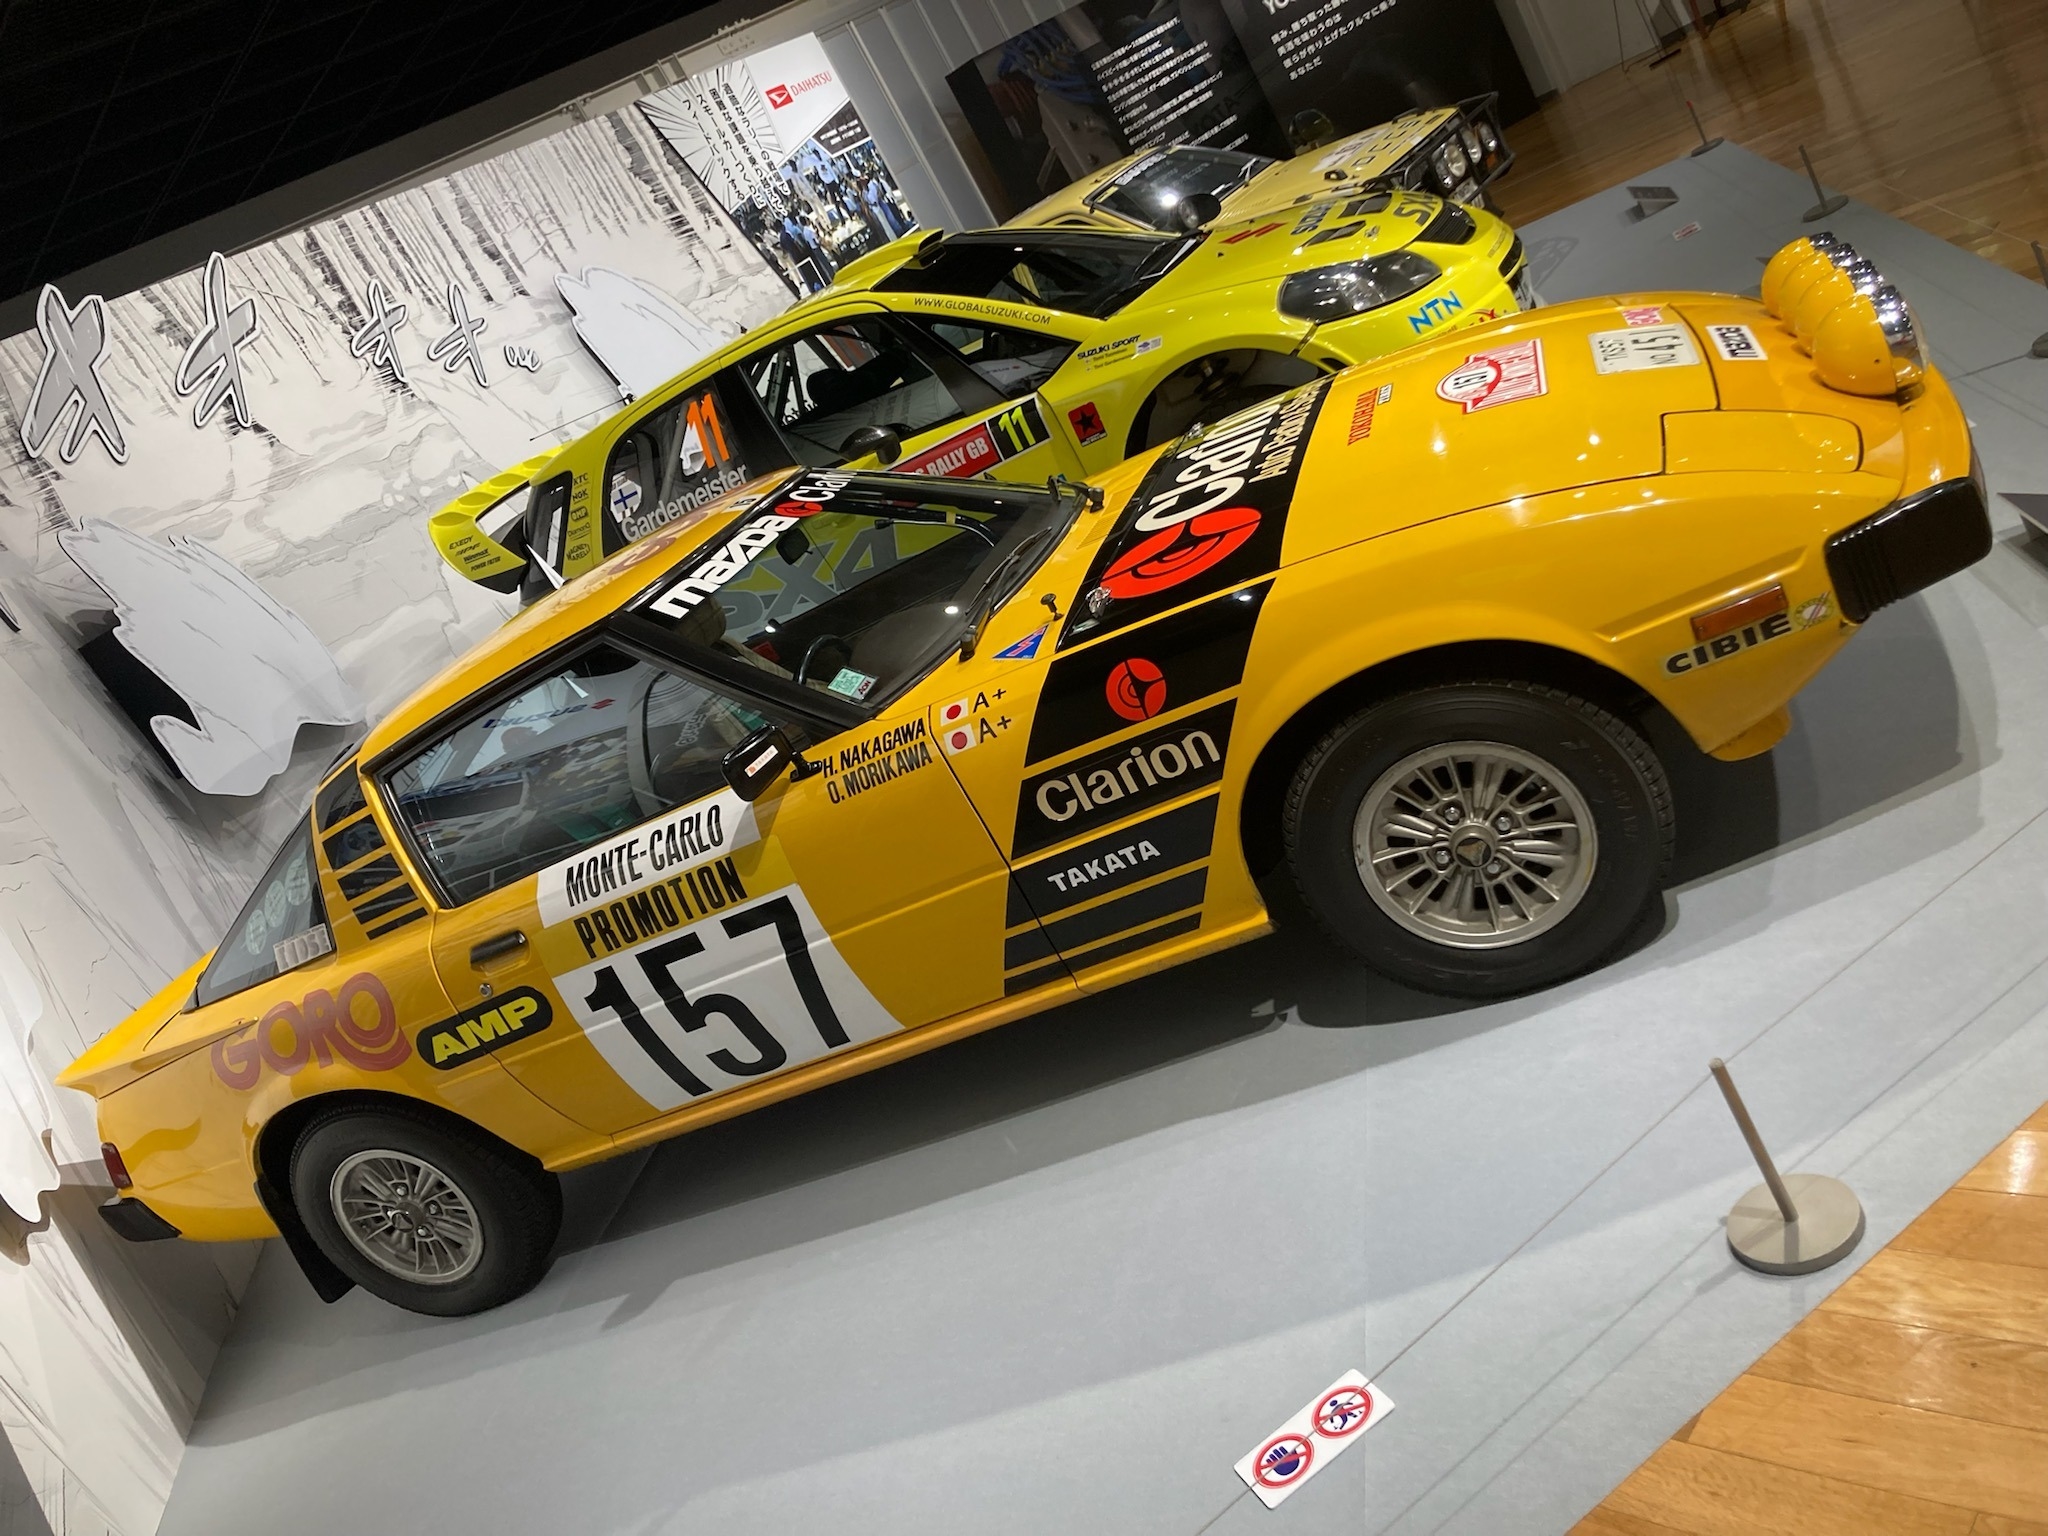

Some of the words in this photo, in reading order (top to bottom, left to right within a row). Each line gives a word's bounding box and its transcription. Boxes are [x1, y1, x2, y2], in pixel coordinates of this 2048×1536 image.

[790, 71, 833, 97] DAIHATSU
[682, 99, 746, 202] フィードバックする
[914, 297, 1051, 325] WWW.GLOBALSUZUKI.COM
[1408, 291, 1464, 334] NTN
[1077, 343, 1111, 360] SUZUKI
[1111, 335, 1141, 350] SPORT
[1629, 328, 1684, 351] 451
[1714, 327, 1759, 358] mazda
[686, 391, 732, 470] 11
[998, 406, 1037, 453] 11
[1347, 387, 1379, 446] YOKOHAMA
[926, 445, 970, 477] RALLY
[967, 437, 989, 460] GB
[1247, 444, 1297, 484] Auto
[573, 488, 589, 502] NGK
[620, 464, 748, 542] Gardemeister
[449, 535, 475, 551] EXEDY
[650, 515, 800, 619] mazda
[973, 687, 1008, 712] A+
[823, 754, 840, 779] H.
[839, 718, 927, 767] NAKAGAWA
[978, 715, 1013, 744] A+
[826, 780, 844, 805] O.
[844, 742, 933, 798] MORIKAWA
[1036, 730, 1221, 822] Clarion
[565, 804, 724, 908] MONTE-CARLO
[1048, 838, 1161, 893] TAKATA
[573, 856, 748, 959] PROMOTION
[583, 894, 851, 1098] 157
[210, 971, 412, 1091] GORO
[431, 995, 538, 1064] AMP
